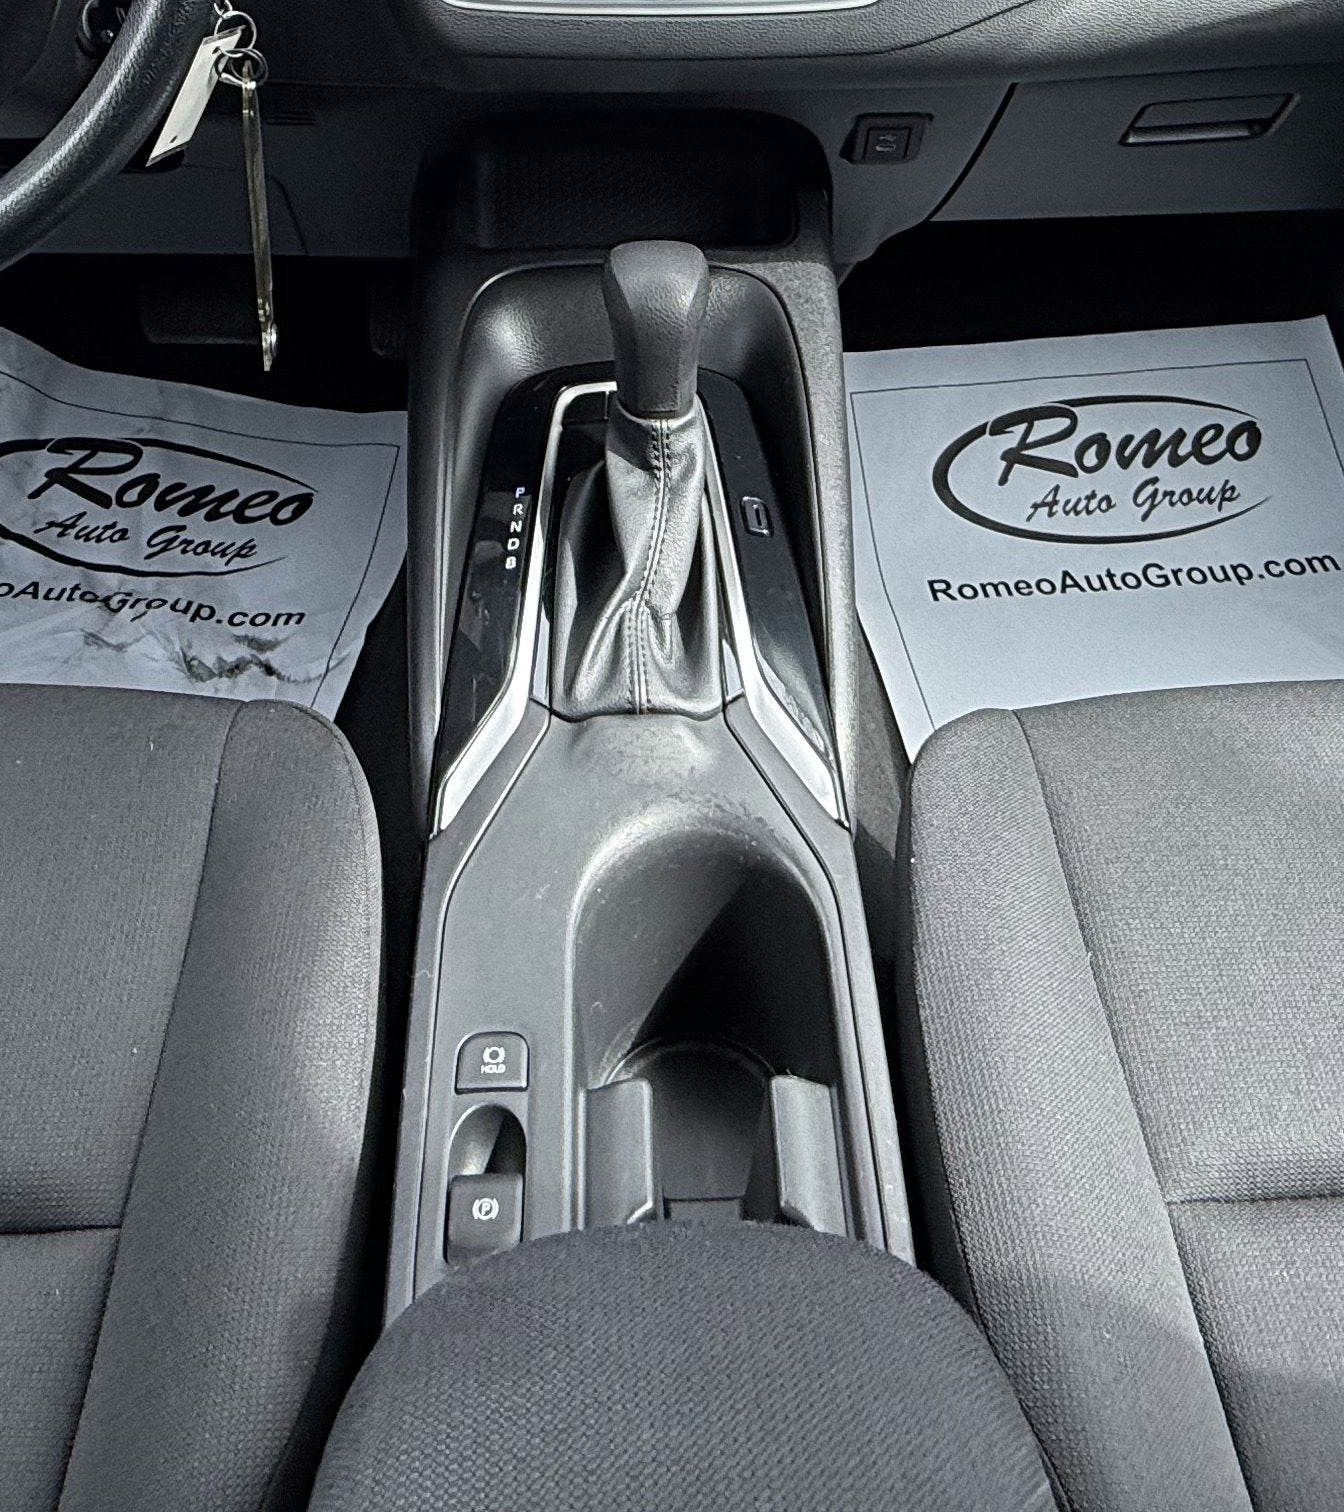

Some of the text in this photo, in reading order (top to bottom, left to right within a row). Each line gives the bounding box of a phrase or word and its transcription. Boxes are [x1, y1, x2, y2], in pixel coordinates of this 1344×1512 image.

[987, 404, 1263, 487] Romeo
[27, 437, 317, 528] Romeo
[515, 486, 526, 499] P
[512, 503, 524, 516] R
[1025, 475, 1242, 523] Auto Group
[34, 511, 260, 563] Auto Group
[509, 520, 523, 533] N
[507, 537, 520, 551] D
[927, 550, 1342, 603] RomeoAutoGroup.com
[480, 1064, 506, 1074] HOLD
